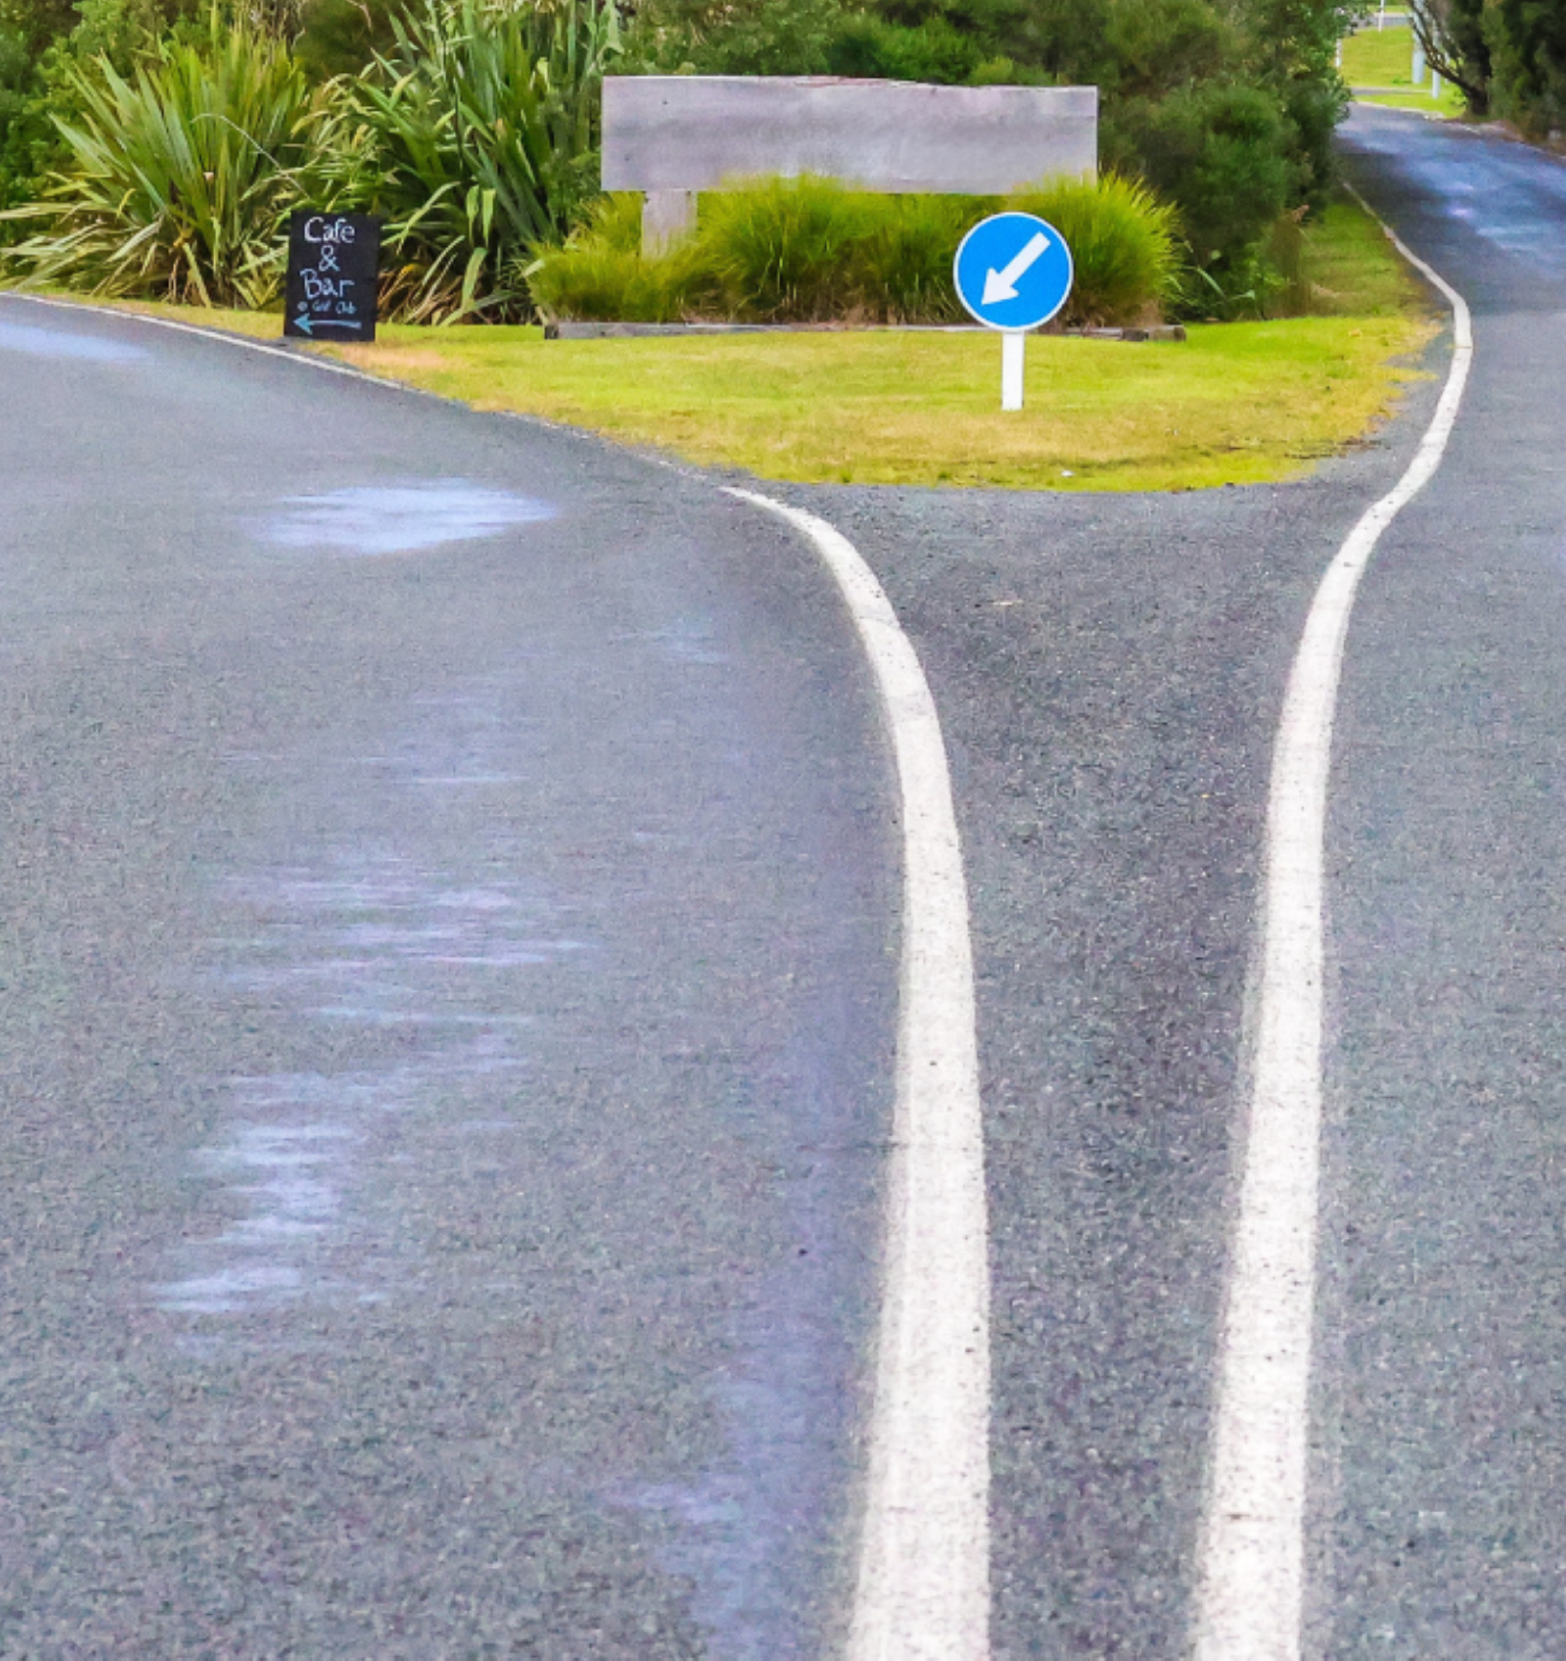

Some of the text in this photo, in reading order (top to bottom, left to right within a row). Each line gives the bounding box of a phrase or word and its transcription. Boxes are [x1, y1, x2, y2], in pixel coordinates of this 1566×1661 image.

[304, 216, 355, 243] Cafe
[318, 244, 340, 272] &
[299, 268, 355, 299] Bar
